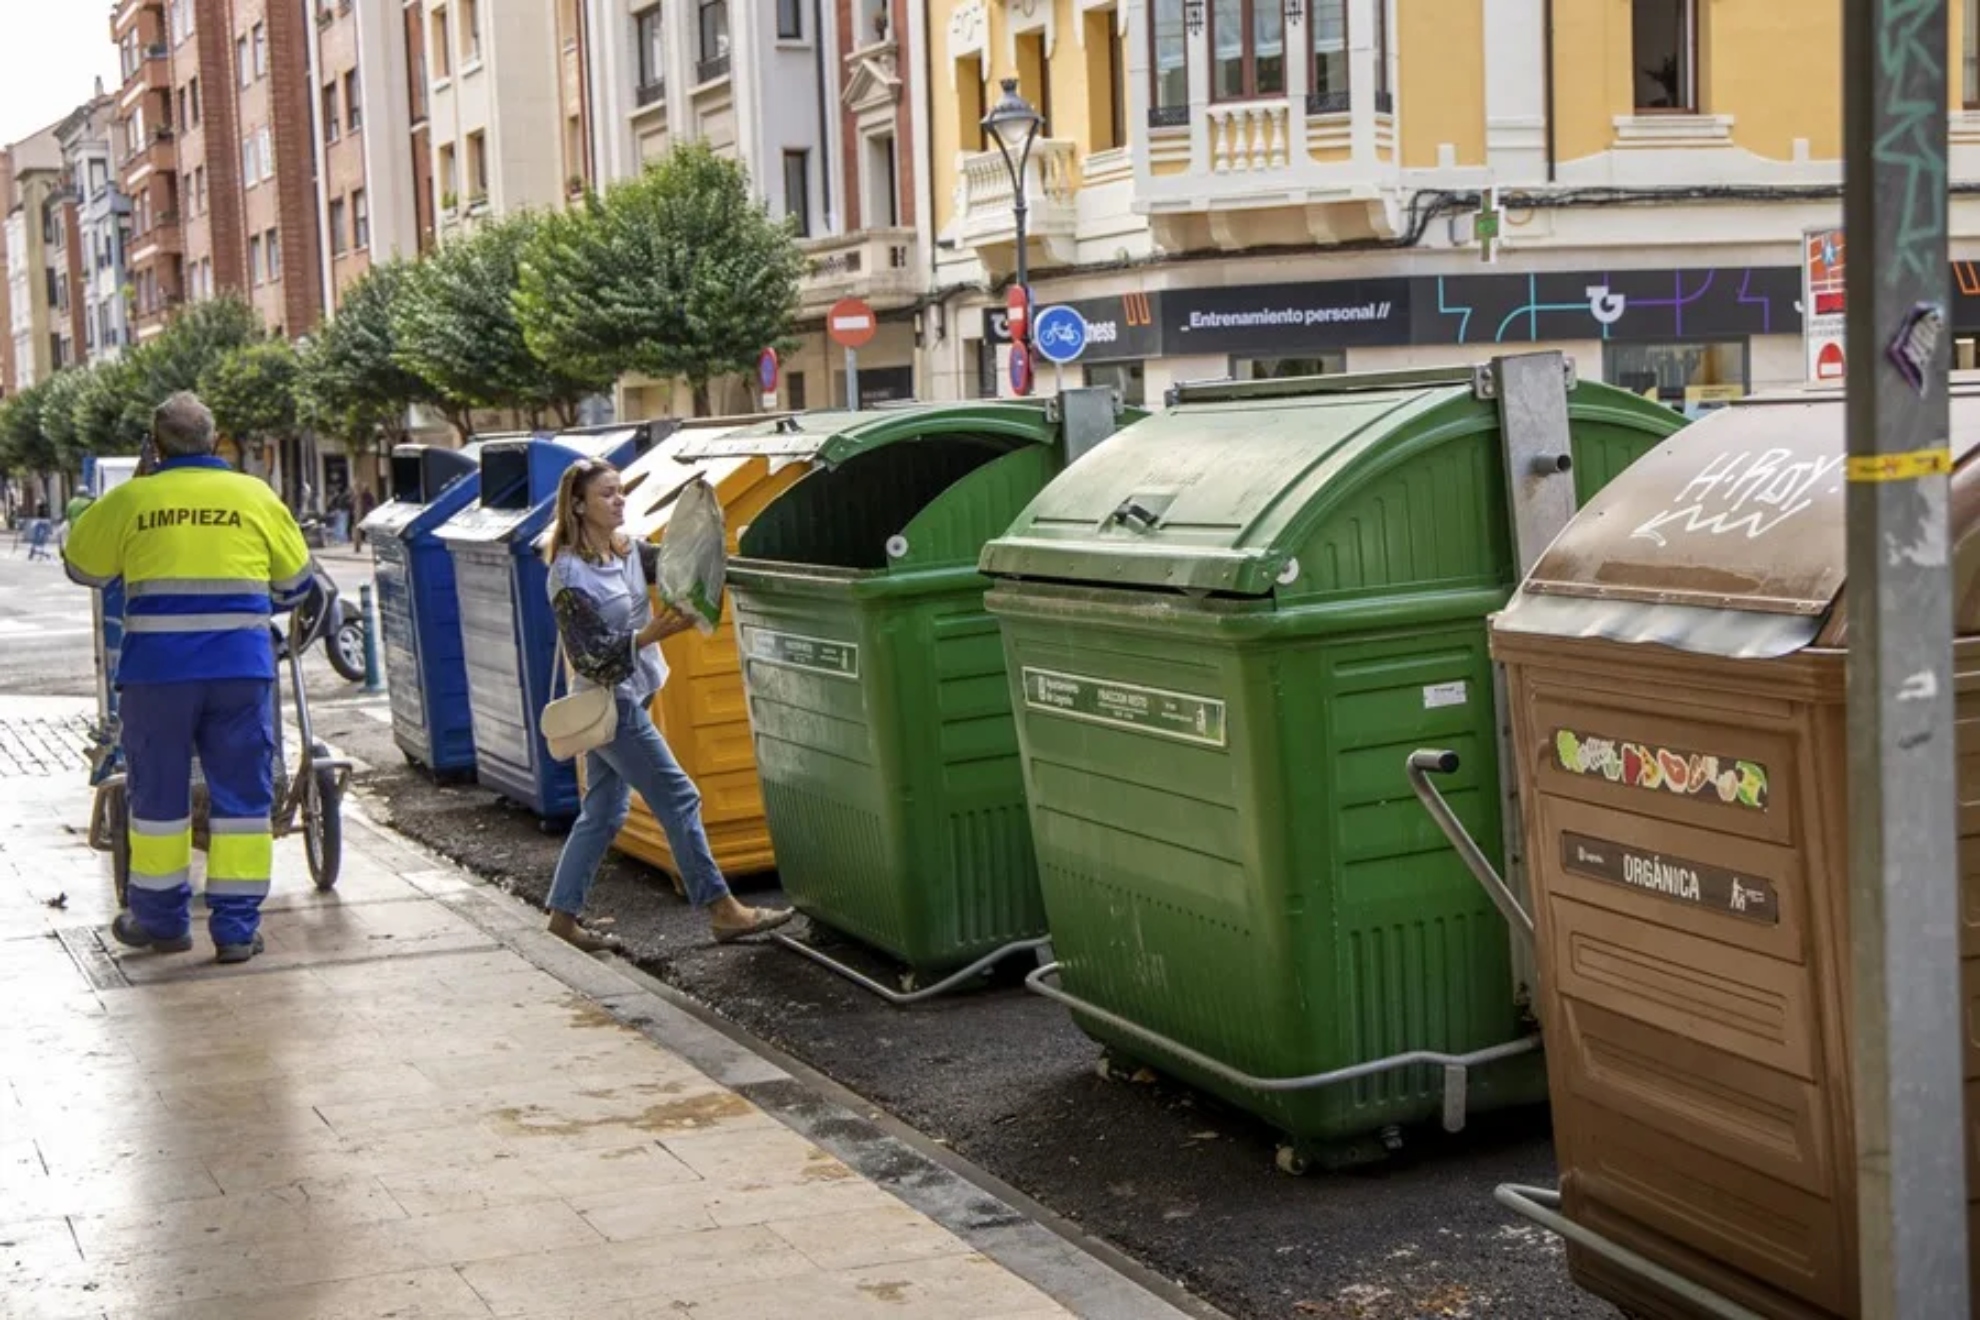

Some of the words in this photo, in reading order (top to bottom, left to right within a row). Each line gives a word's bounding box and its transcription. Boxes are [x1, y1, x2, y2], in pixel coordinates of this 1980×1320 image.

[1305, 303, 1375, 325] personal
[137, 508, 242, 531] LIMPIEZA
[1623, 853, 1700, 901] ORGÁNICA
